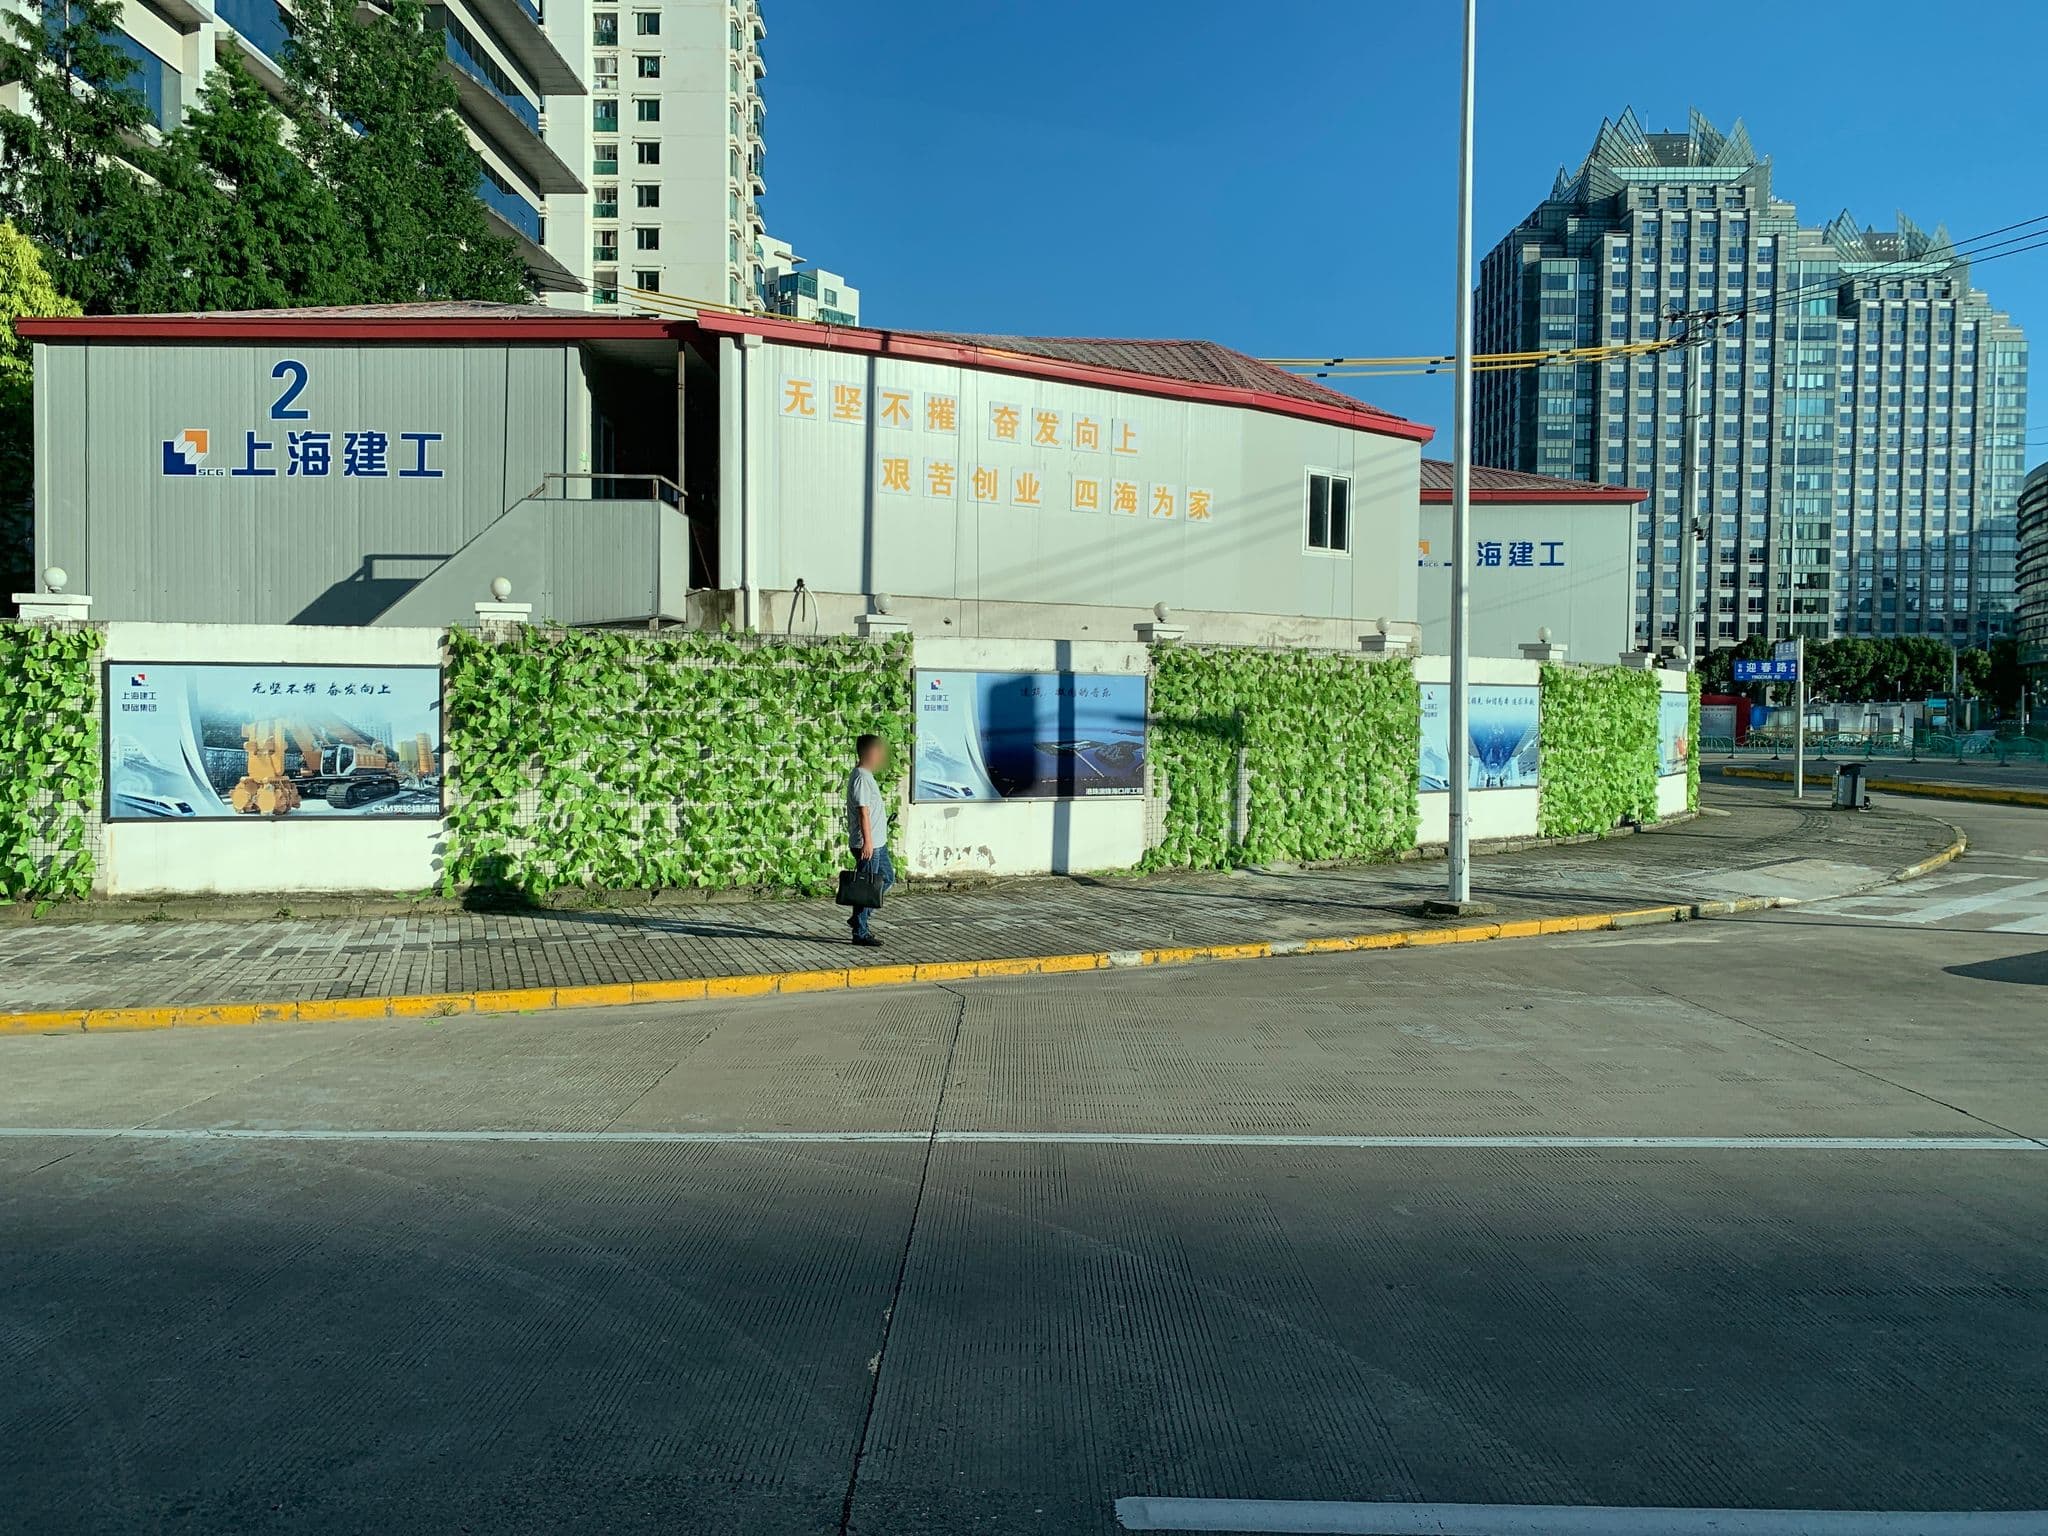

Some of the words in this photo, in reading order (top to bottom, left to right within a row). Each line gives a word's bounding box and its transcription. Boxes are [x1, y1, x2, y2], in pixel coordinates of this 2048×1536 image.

[270, 359, 310, 420] 2
[784, 379, 957, 433] 无坚不摧
[992, 406, 1138, 453] 奋发向上
[231, 431, 444, 477] 上海建工
[198, 468, 224, 476] SCG
[881, 458, 1040, 504] 艰苦创业
[1074, 479, 1212, 521] 四海为家
[1443, 541, 1565, 567] 海建工
[1746, 662, 1787, 672] 迎春路
[121, 691, 157, 700] 上海建工
[326, 682, 392, 696] 奋发向上
